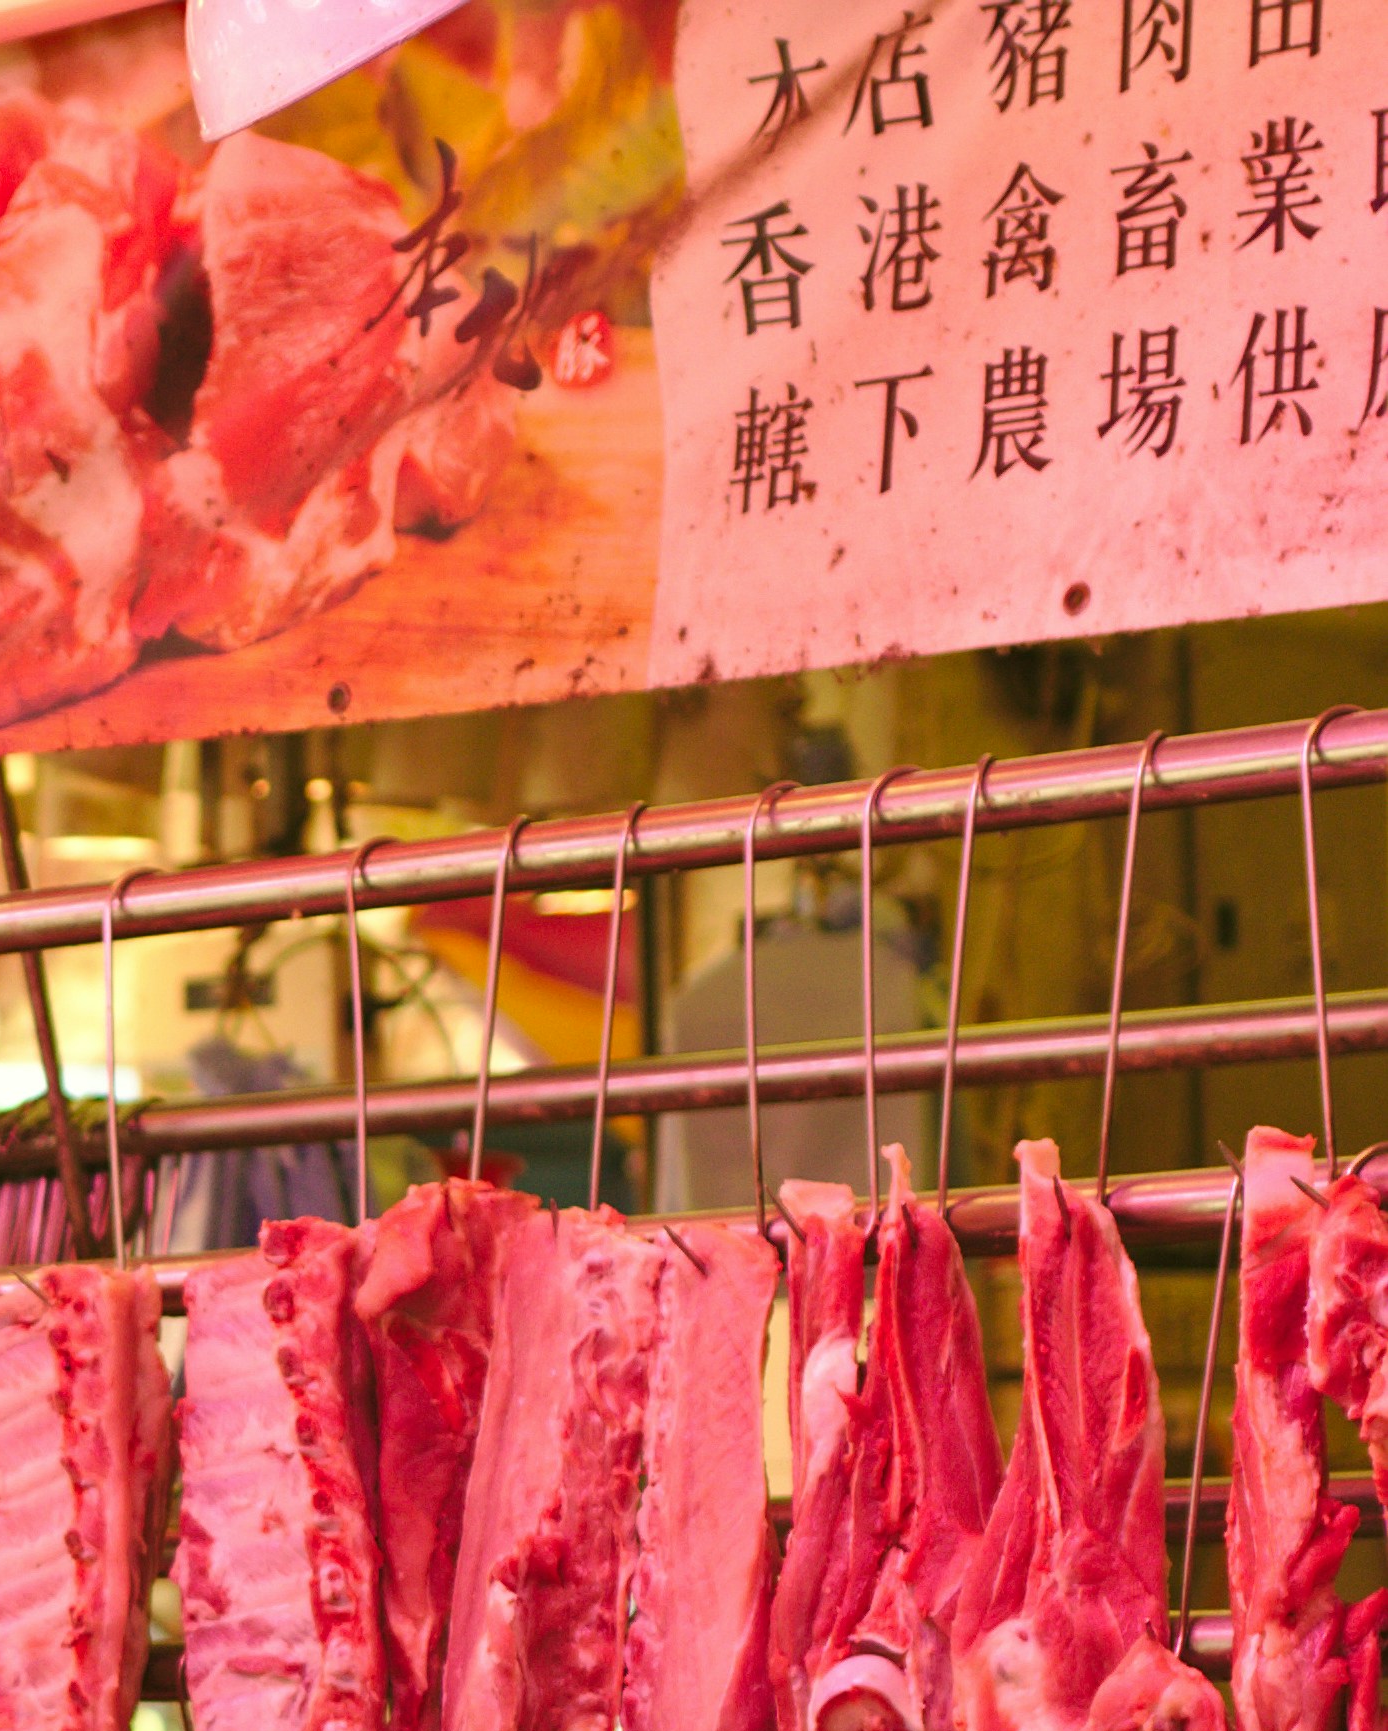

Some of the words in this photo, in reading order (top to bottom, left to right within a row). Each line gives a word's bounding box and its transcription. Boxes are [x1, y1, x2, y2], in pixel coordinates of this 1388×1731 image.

[721, 107, 1388, 335] 香港禽畜業
